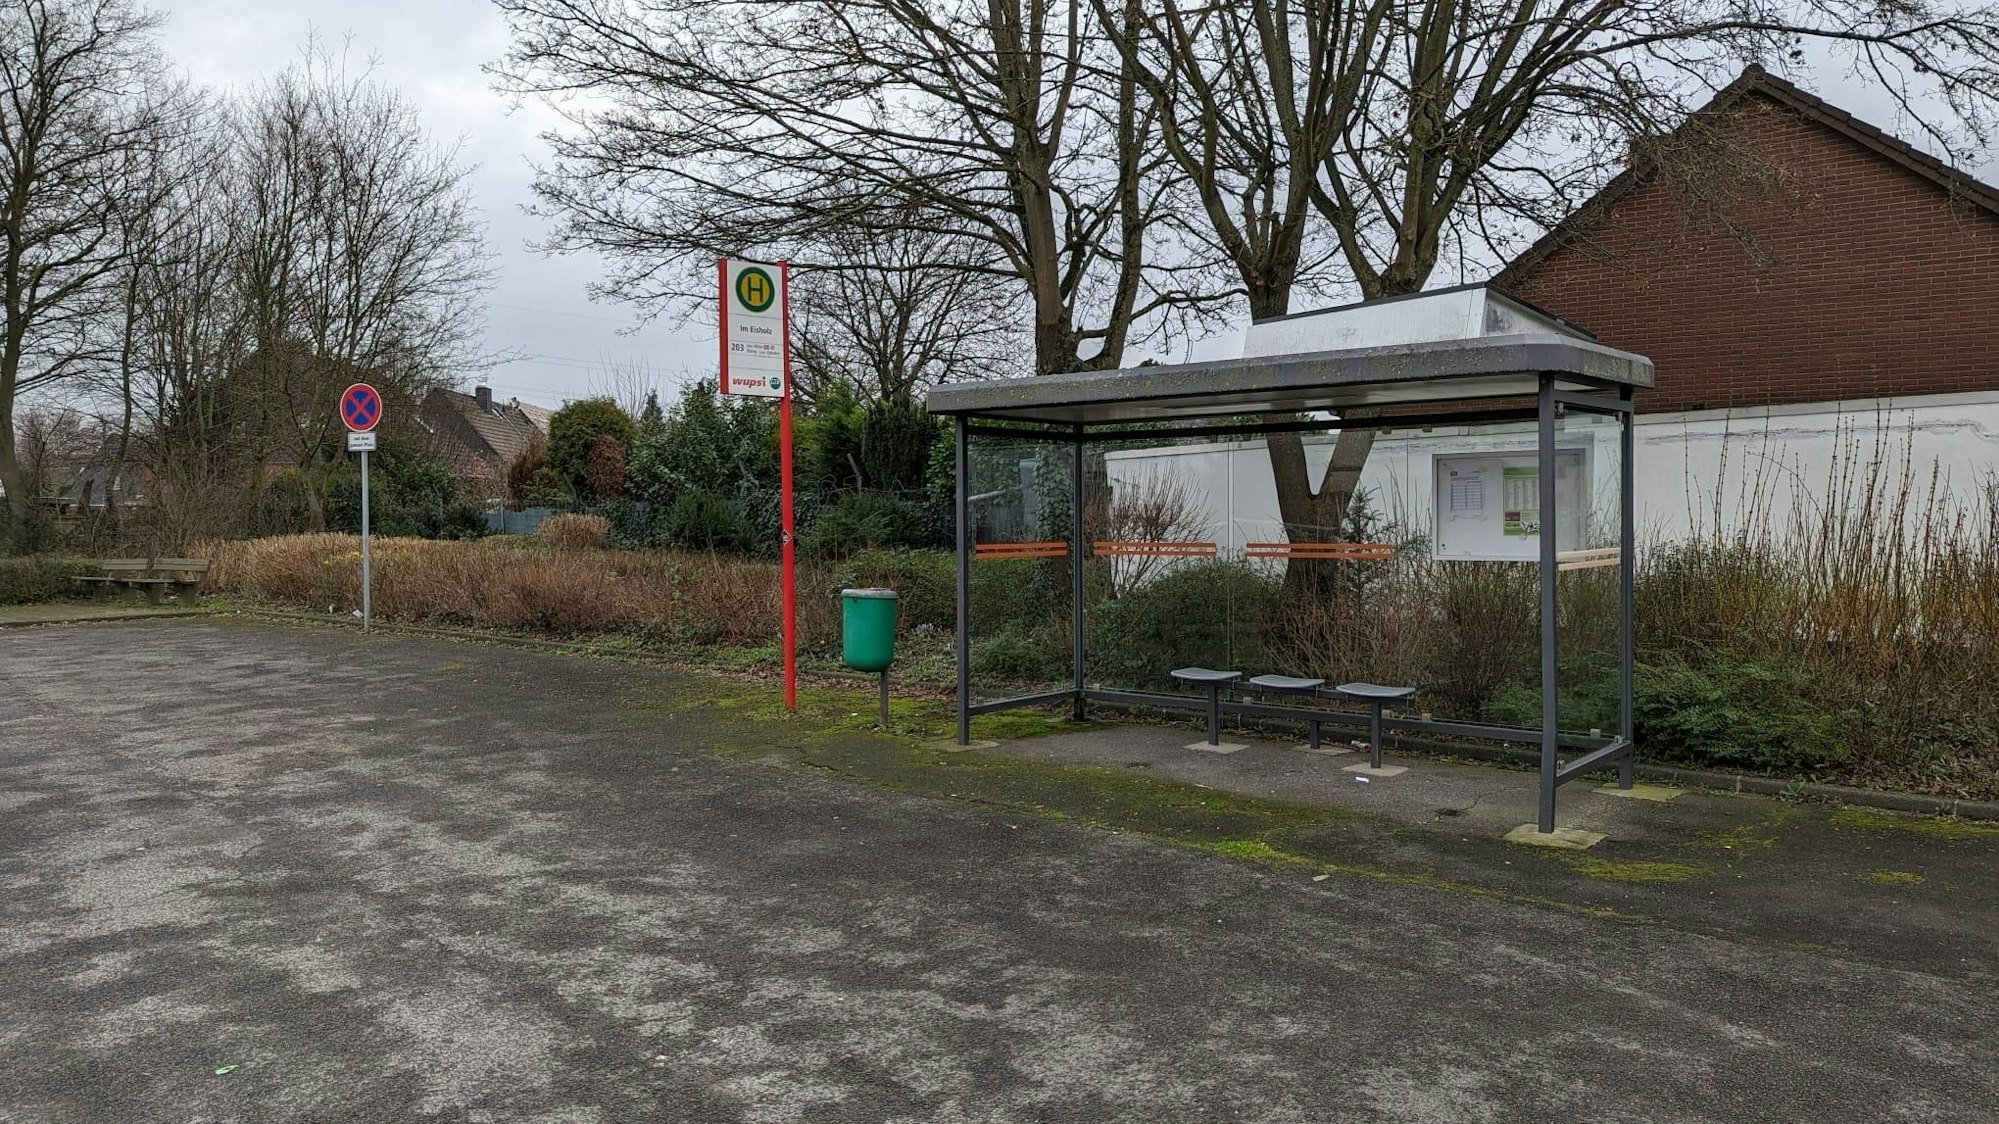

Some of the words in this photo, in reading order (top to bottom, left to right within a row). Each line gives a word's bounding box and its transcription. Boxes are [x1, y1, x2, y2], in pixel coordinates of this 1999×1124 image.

[748, 277, 763, 303] H
[740, 324, 748, 334] Im
[750, 325, 772, 335] Eisholz
[731, 343, 744, 352] 203
[732, 376, 765, 389] wupsi
